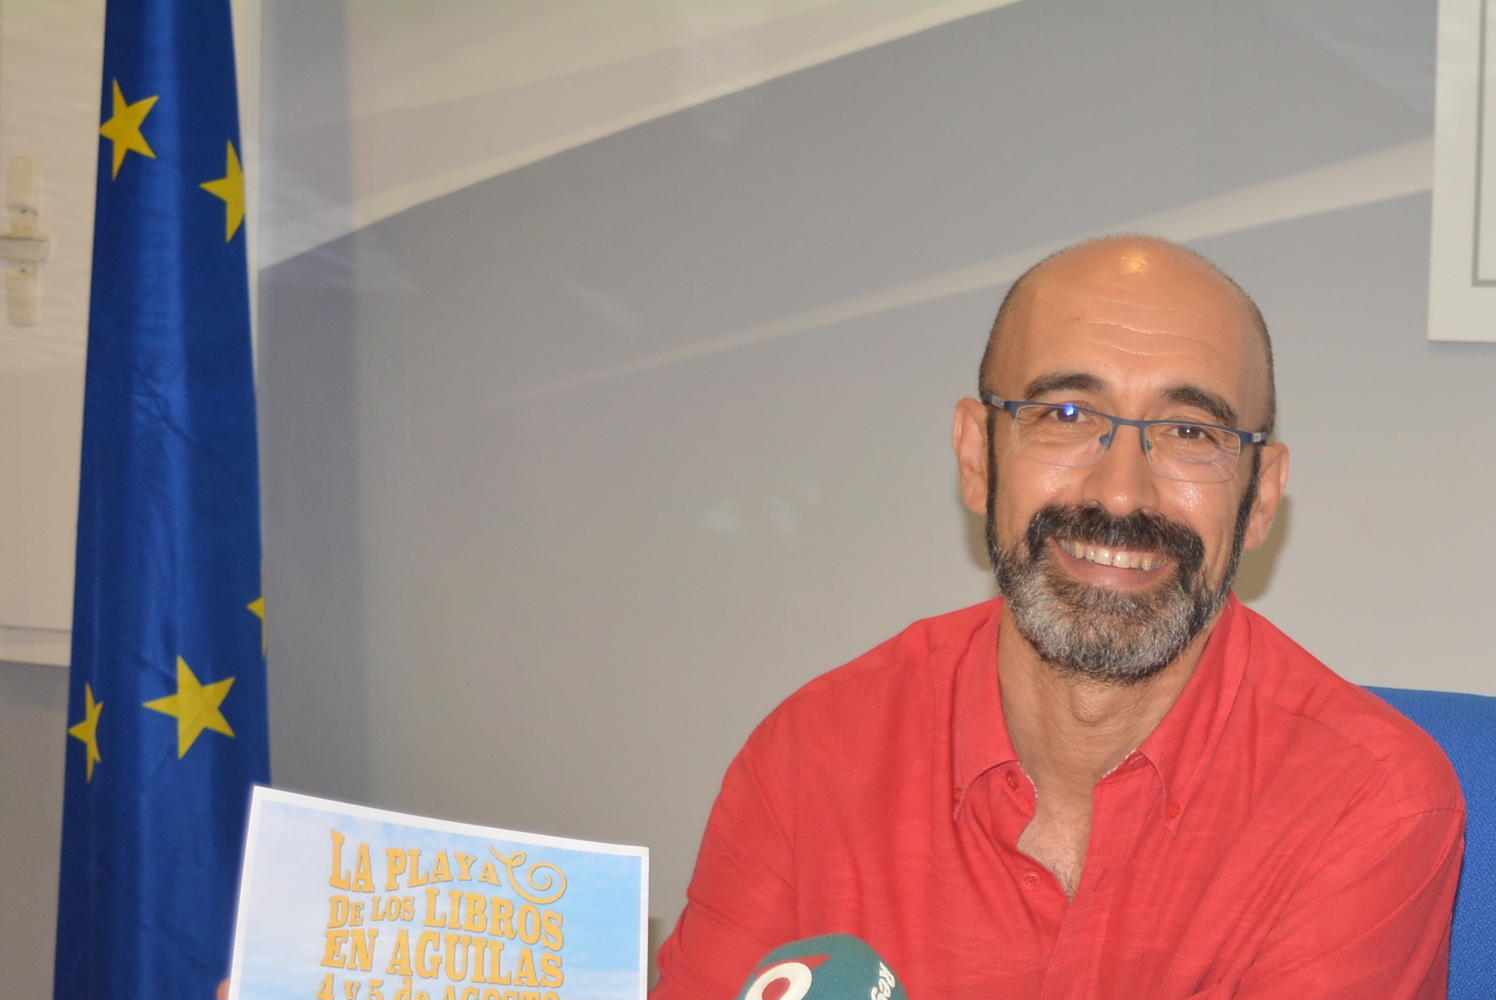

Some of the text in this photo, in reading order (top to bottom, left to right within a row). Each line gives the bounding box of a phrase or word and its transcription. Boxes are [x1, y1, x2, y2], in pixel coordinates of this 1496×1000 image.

[330, 829, 501, 893] LA PLAYA
[327, 887, 564, 951] DE LOS LIBROS
[321, 928, 564, 988] EN AGUILAS
